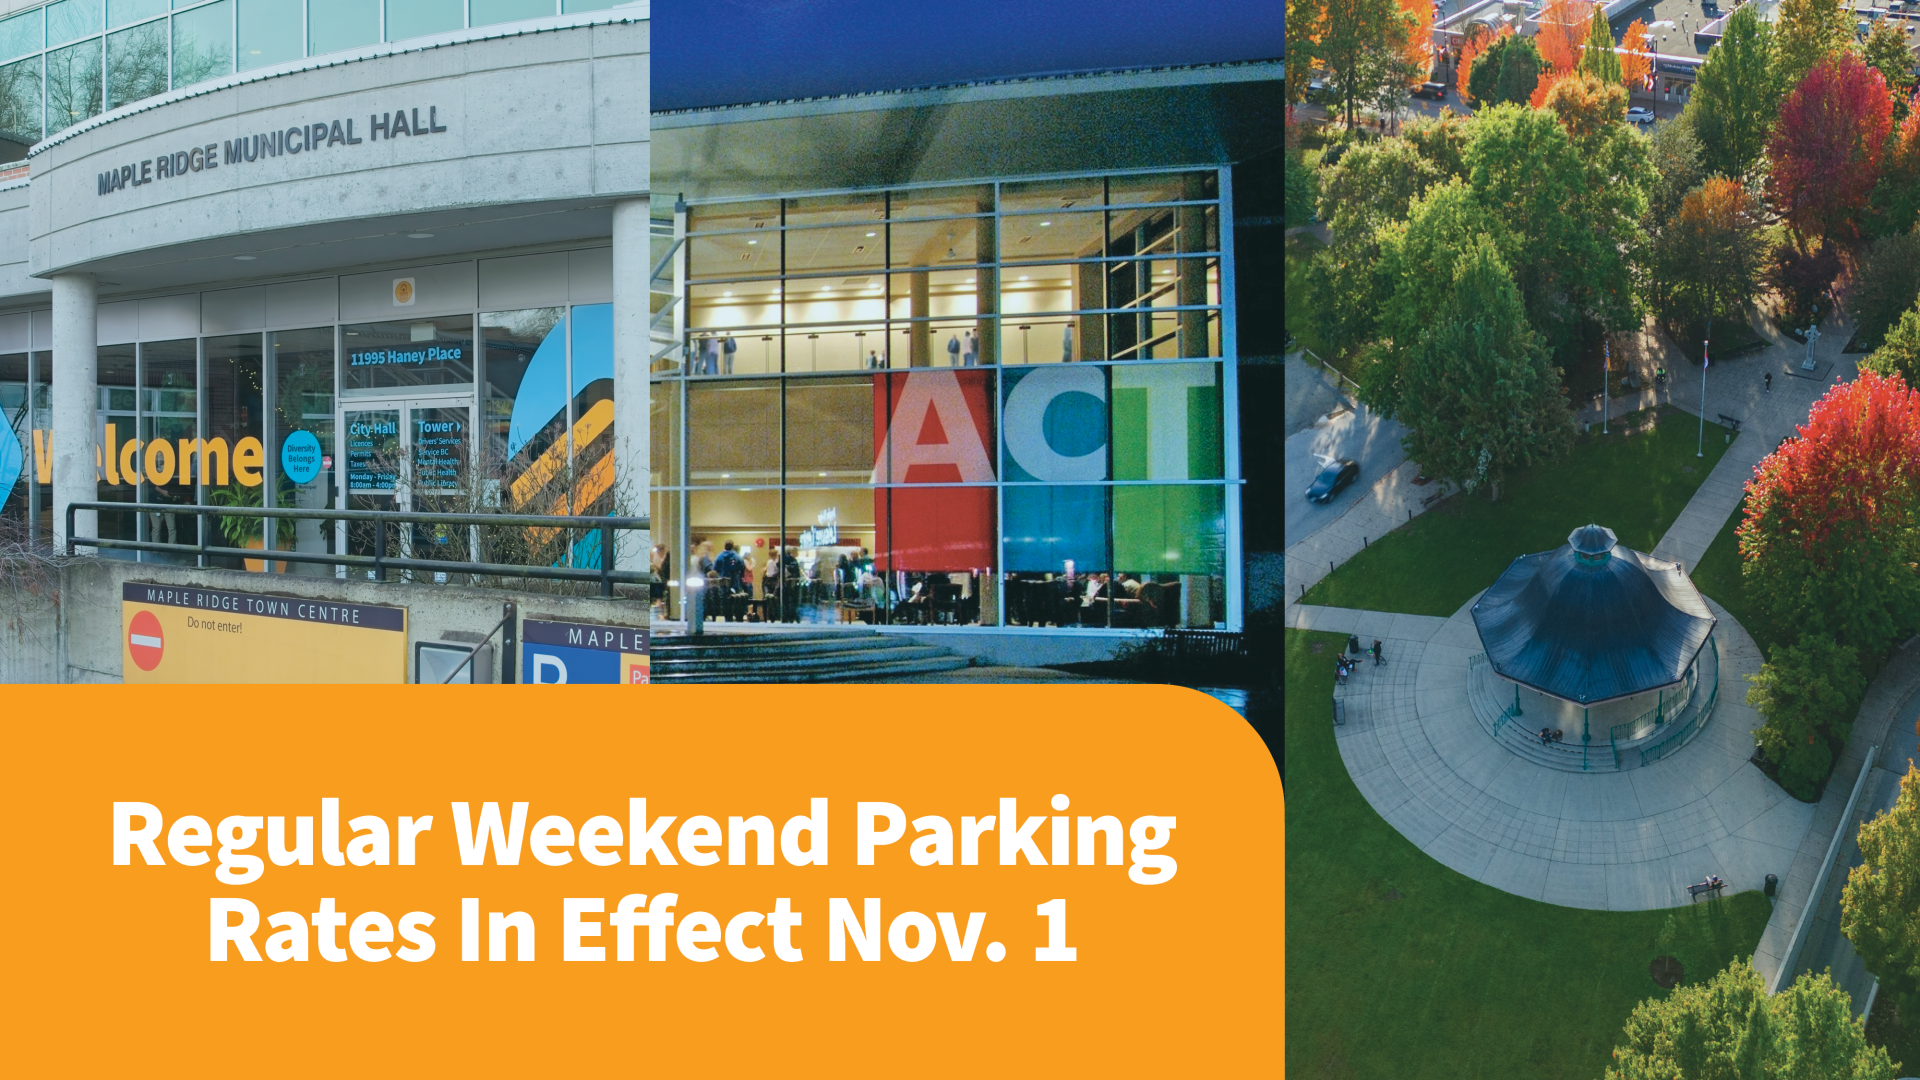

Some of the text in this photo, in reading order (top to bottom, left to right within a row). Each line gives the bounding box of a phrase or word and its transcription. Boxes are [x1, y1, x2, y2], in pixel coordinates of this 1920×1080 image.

[97, 105, 447, 196] MAPLE RIDGE MUNICIPAL HALL
[351, 346, 462, 366] 11995 Haney Place
[417, 420, 454, 433] Tower
[870, 362, 1217, 484] ACT
[350, 421, 396, 437] City Hall
[350, 439, 374, 448] Licences
[438, 437, 462, 445] Services
[287, 444, 316, 454] Diversity
[350, 450, 372, 458] Permits
[418, 448, 449, 456] Service BC
[32, 423, 264, 487] Wlcome
[288, 454, 315, 464] Belongs
[350, 460, 367, 468] Taxes
[417, 457, 459, 465] Mental Health
[293, 464, 310, 473] Here
[437, 468, 457, 476] Health
[350, 473, 374, 481] Monday
[350, 481, 372, 489] 8:00am
[437, 479, 458, 489] Library
[147, 588, 360, 624] MAPLE RIDGE TOWN CENTRE
[187, 615, 243, 634] Do not enter!
[568, 628, 643, 651] MAPLE
[633, 670, 650, 684] Pa
